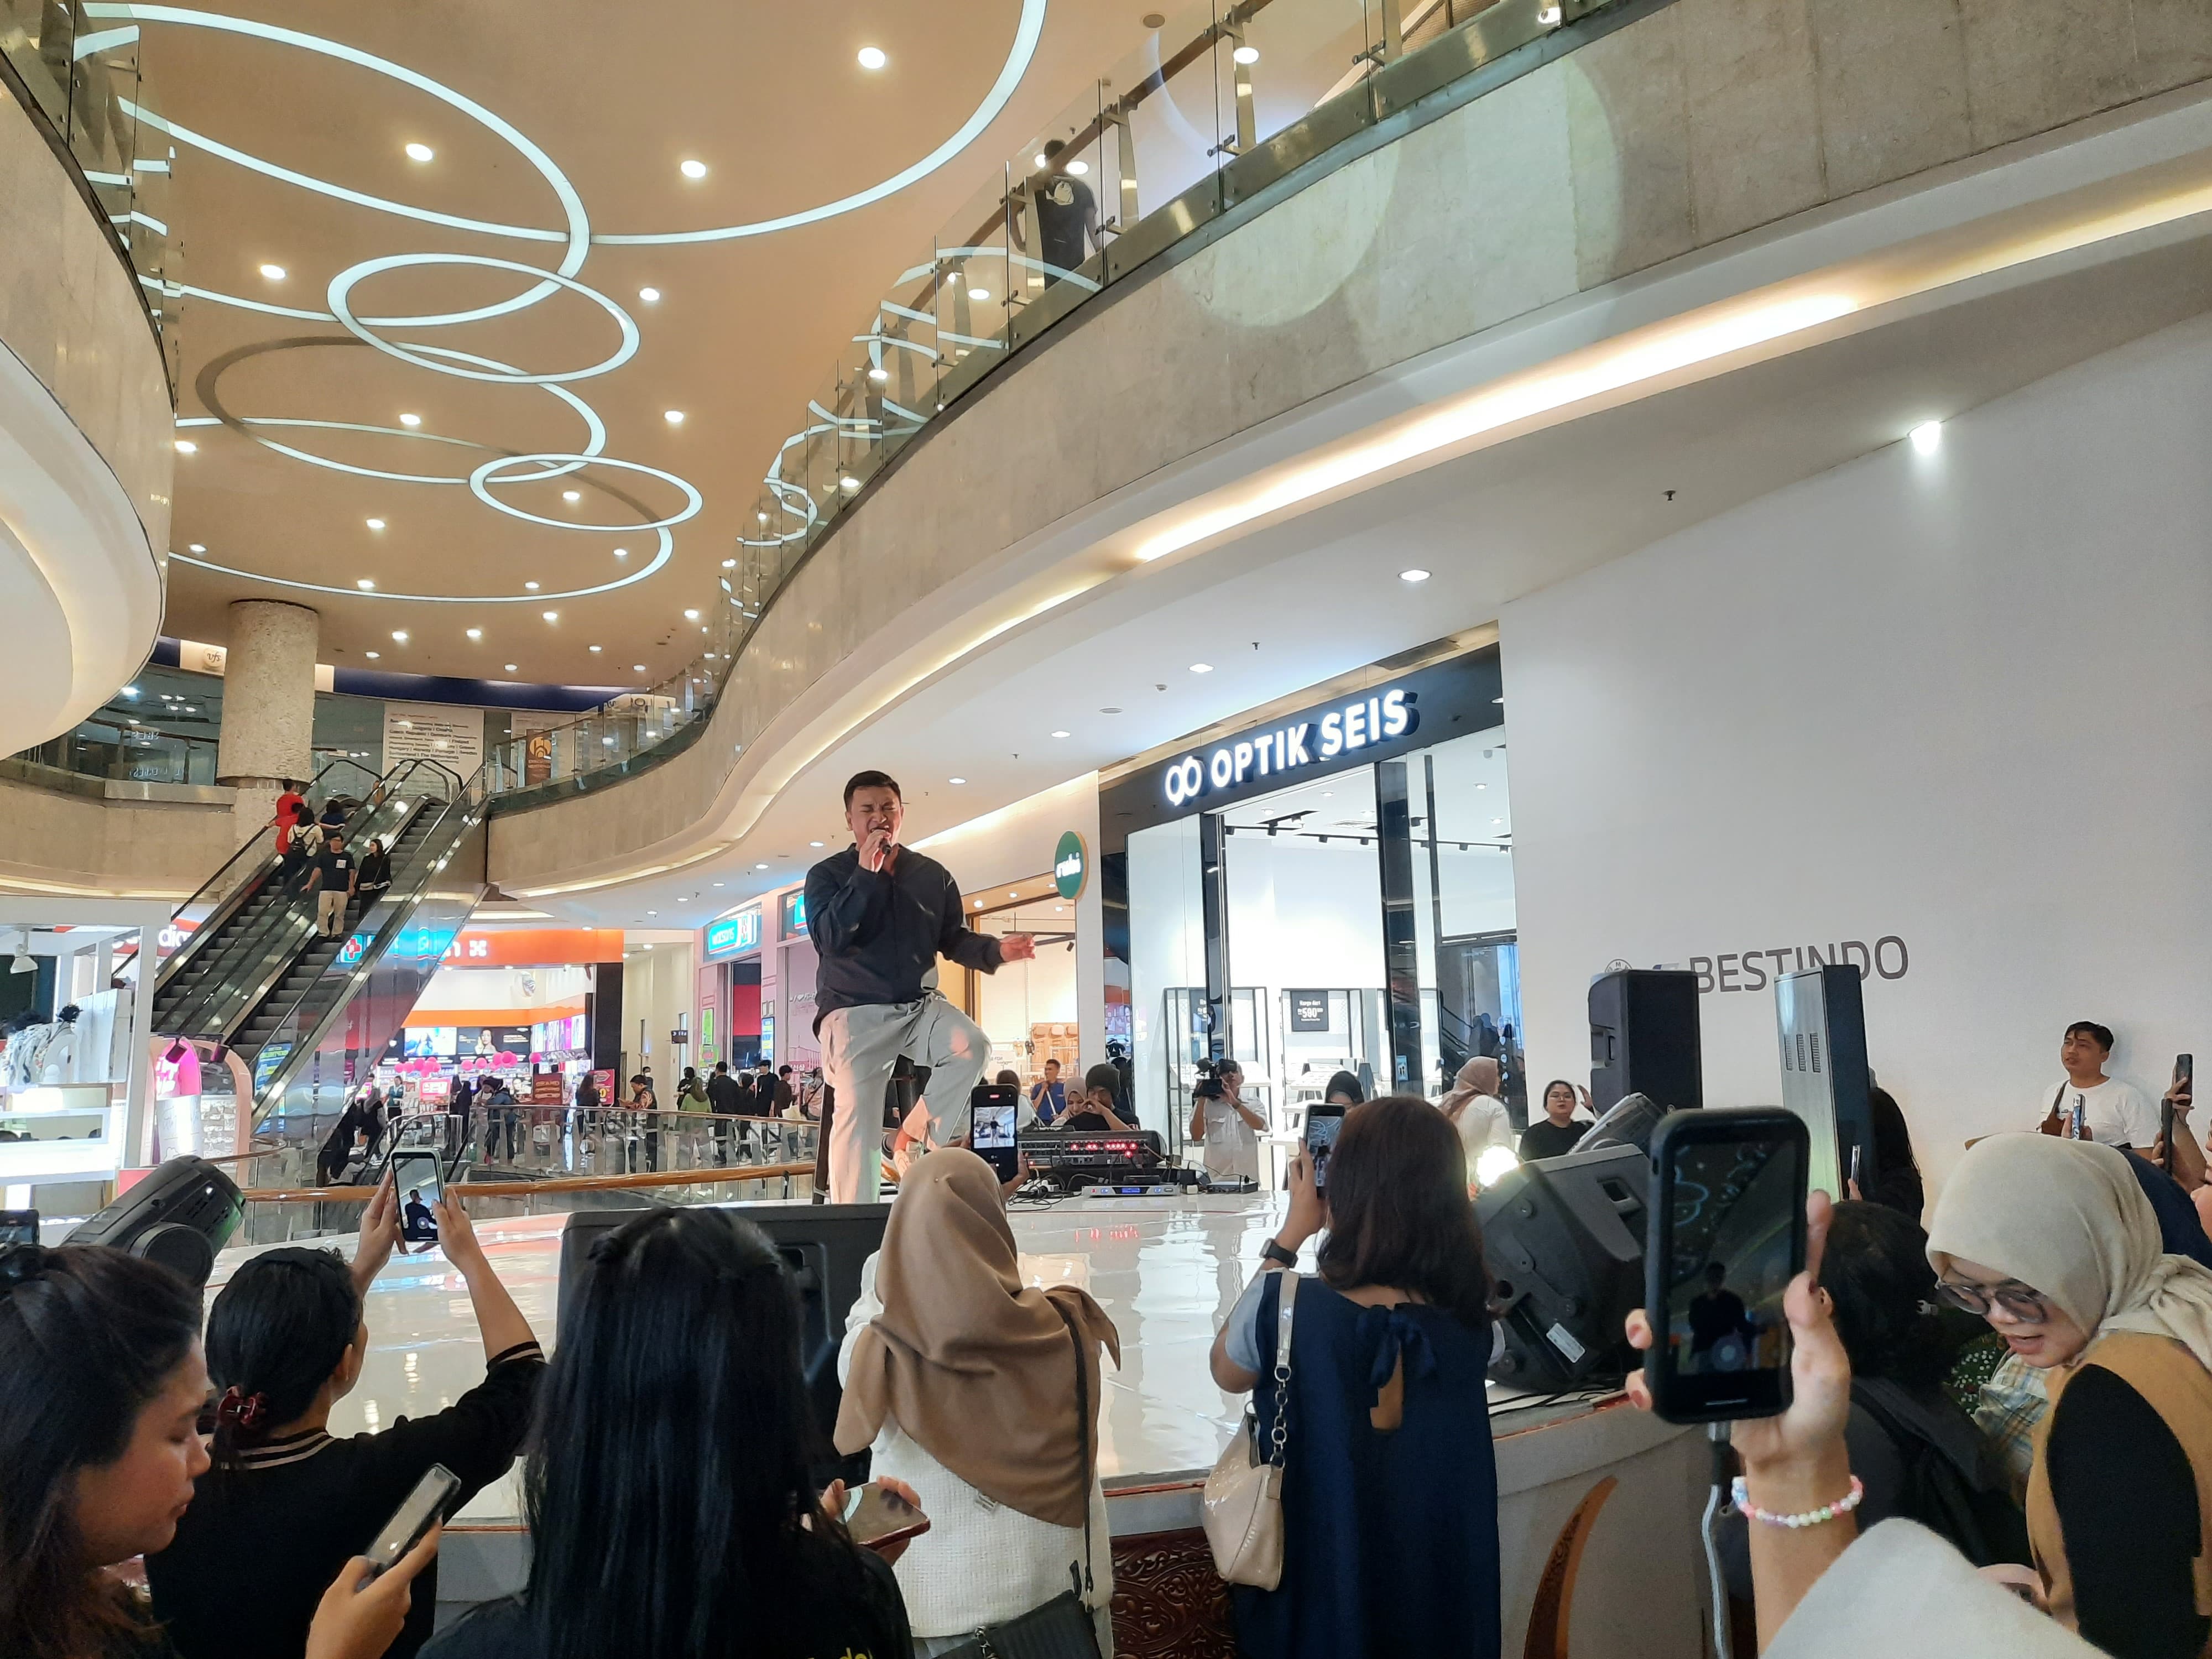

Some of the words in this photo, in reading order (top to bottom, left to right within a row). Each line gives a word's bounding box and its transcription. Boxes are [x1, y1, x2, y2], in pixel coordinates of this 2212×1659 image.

[1211, 723, 1309, 788] OPTIK
[1321, 688, 1410, 756] SEIS
[1689, 935, 1909, 994] BESTINDO
